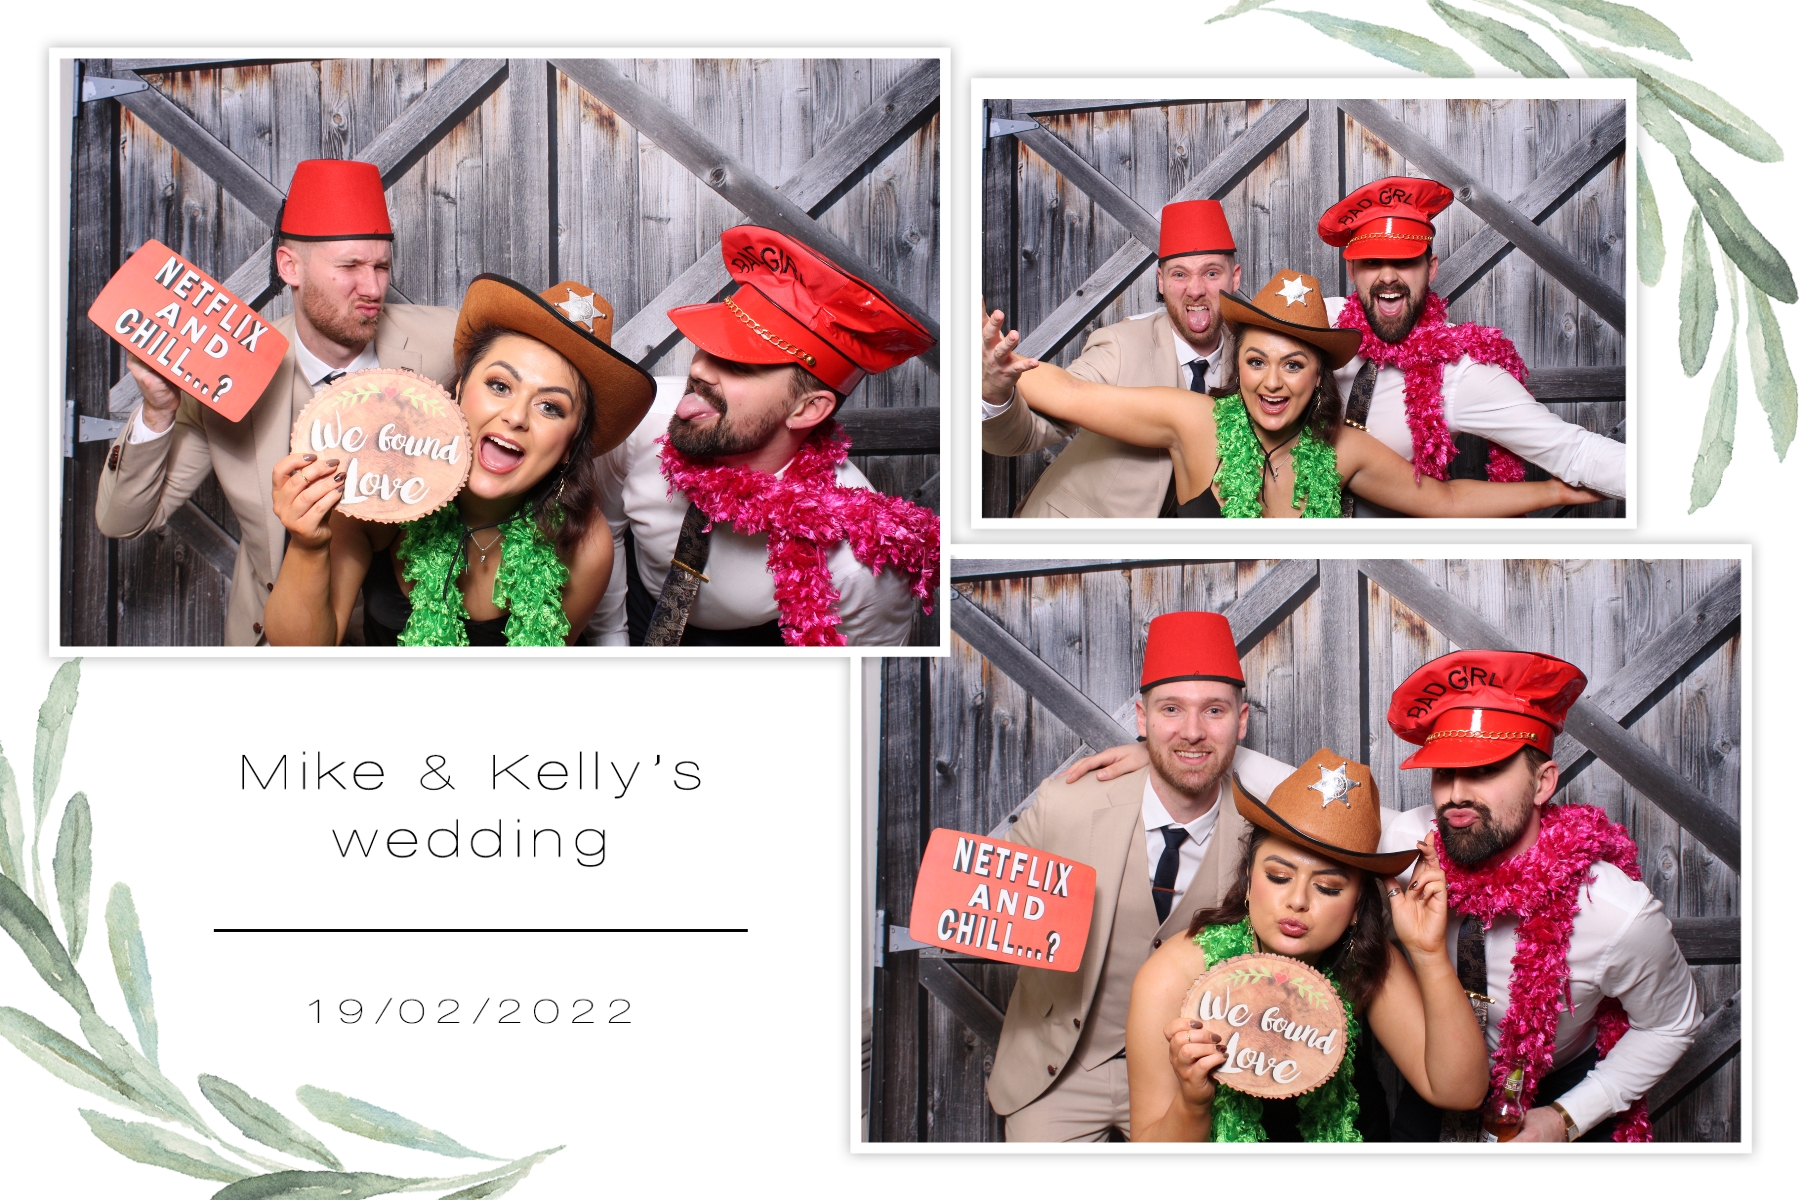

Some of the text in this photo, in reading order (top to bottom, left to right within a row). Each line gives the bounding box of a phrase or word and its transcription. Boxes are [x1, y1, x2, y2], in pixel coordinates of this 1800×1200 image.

[1338, 198, 1373, 226] BAD
[154, 255, 269, 353] NETFLIX
[154, 301, 229, 360] AND
[310, 409, 462, 466] We found
[338, 457, 431, 505] Love
[1407, 682, 1447, 719] BAD
[952, 836, 1073, 897] NETFLIX
[967, 883, 1045, 921] AND
[1199, 985, 1338, 1055] We found
[1217, 1031, 1302, 1084] Love
